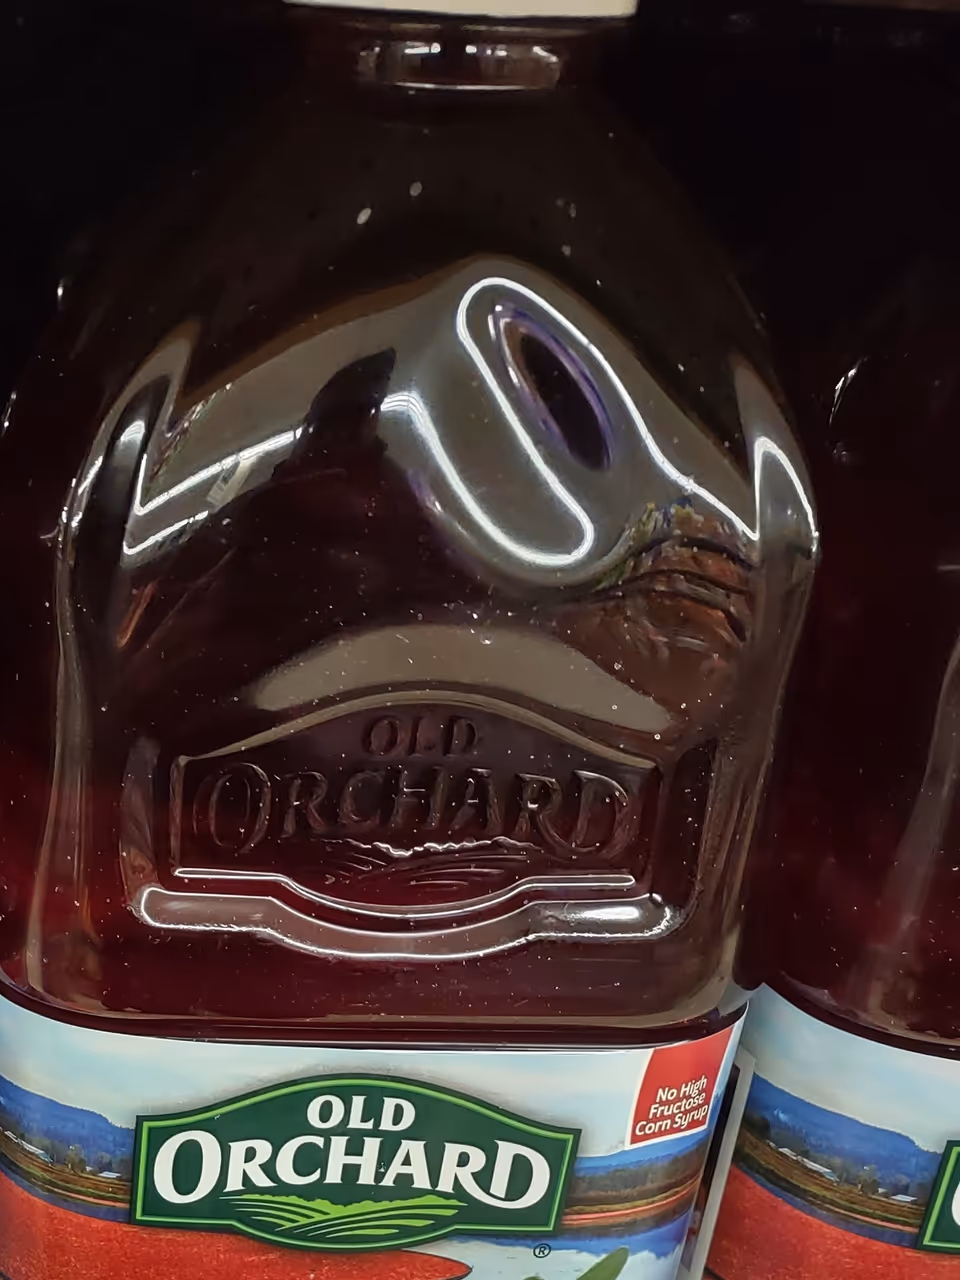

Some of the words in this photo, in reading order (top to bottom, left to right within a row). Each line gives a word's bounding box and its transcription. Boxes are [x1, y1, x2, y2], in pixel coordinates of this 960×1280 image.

[360, 714, 478, 756] OLD
[192, 762, 640, 859] ORCHARD
[649, 1092, 706, 1119] Fructose
[655, 1087, 678, 1103] No
[680, 1075, 708, 1098] High
[306, 1095, 416, 1132] OLD
[635, 1119, 671, 1136] Corn
[672, 1105, 708, 1129] Syrup
[153, 1130, 551, 1210] ORCHARD
